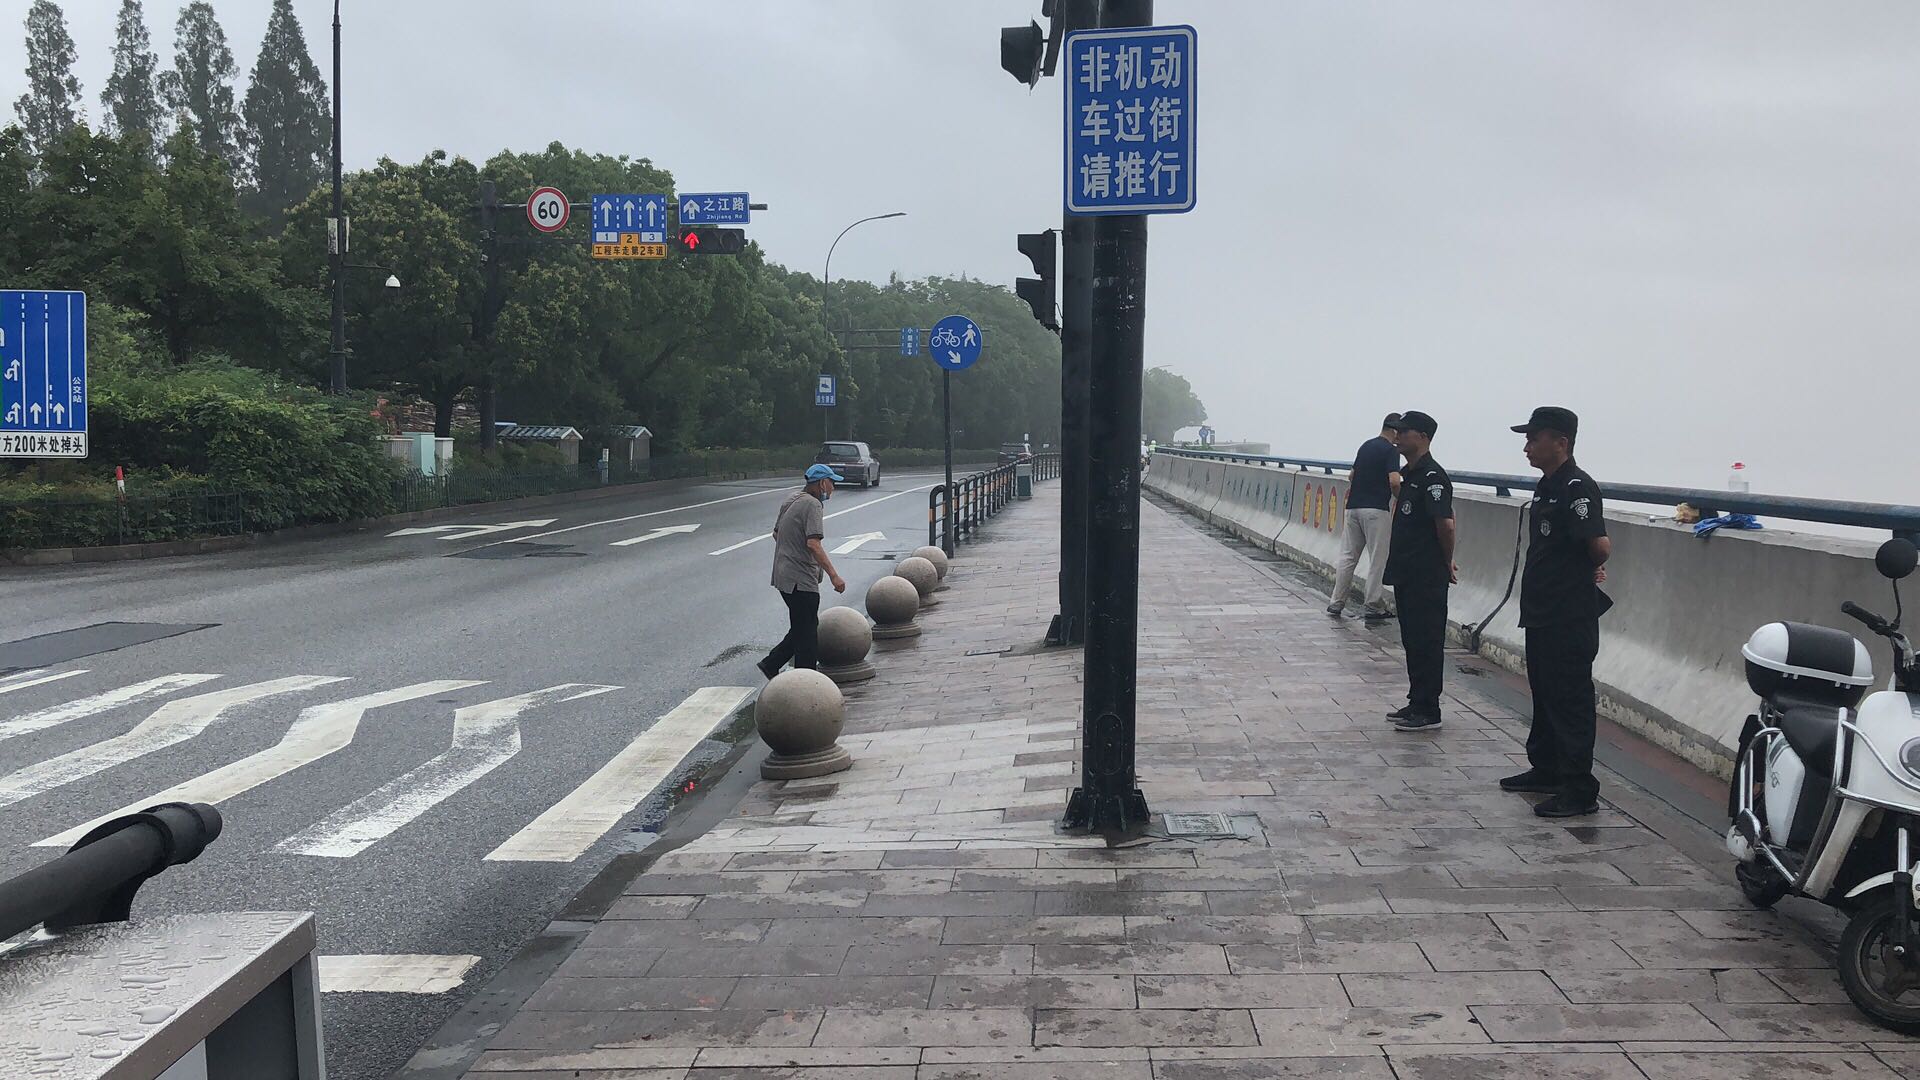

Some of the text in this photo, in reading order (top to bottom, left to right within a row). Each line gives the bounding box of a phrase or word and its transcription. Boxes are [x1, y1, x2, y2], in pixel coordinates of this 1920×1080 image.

[1080, 42, 1182, 93] 非机动
[1081, 97, 1182, 146] 车过街
[1080, 150, 1181, 199] 请推行
[537, 200, 559, 220] 60
[703, 197, 744, 211] 之江路
[626, 235, 632, 243] 2
[649, 233, 655, 241] 3
[595, 246, 664, 256] 工程车走第2车道
[72, 376, 82, 403] 公交站
[0, 435, 83, 453] 方200米处掉头
